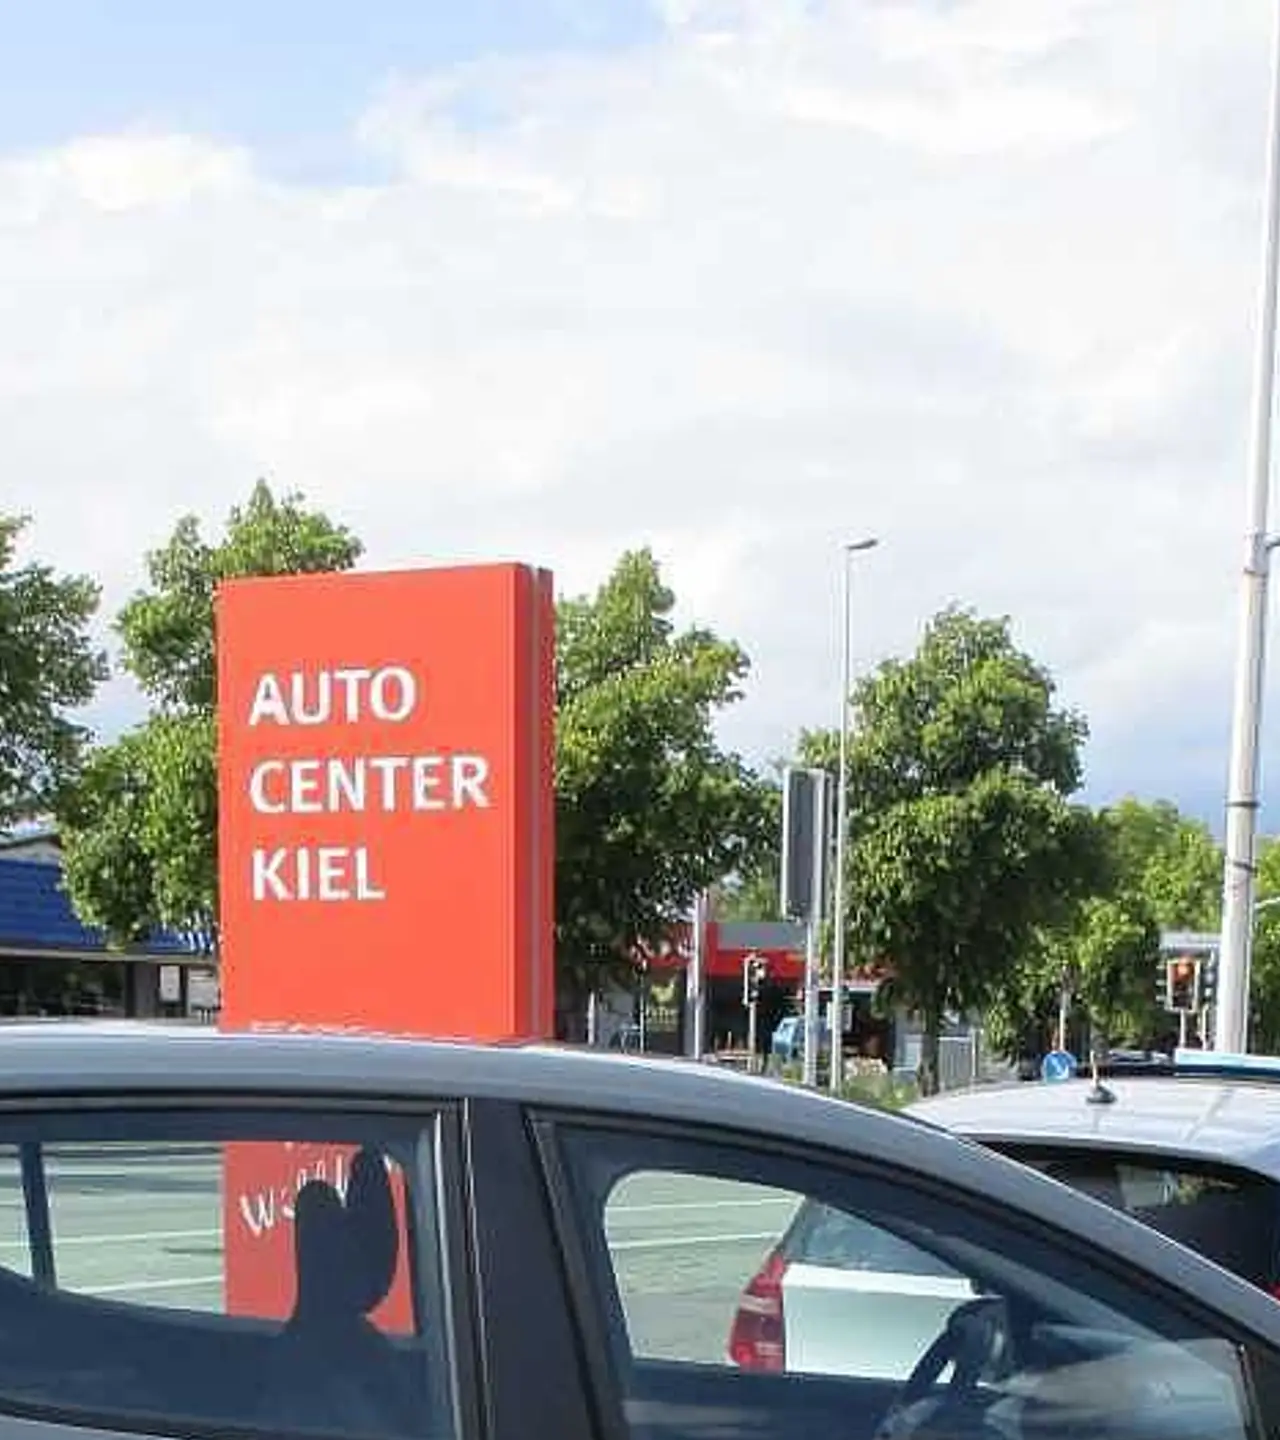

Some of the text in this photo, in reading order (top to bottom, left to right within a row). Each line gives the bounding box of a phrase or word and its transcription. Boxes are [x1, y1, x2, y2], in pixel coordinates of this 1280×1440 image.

[249, 666, 417, 727] AUTO
[249, 754, 492, 813] CENTER
[251, 846, 387, 901] KIEL
